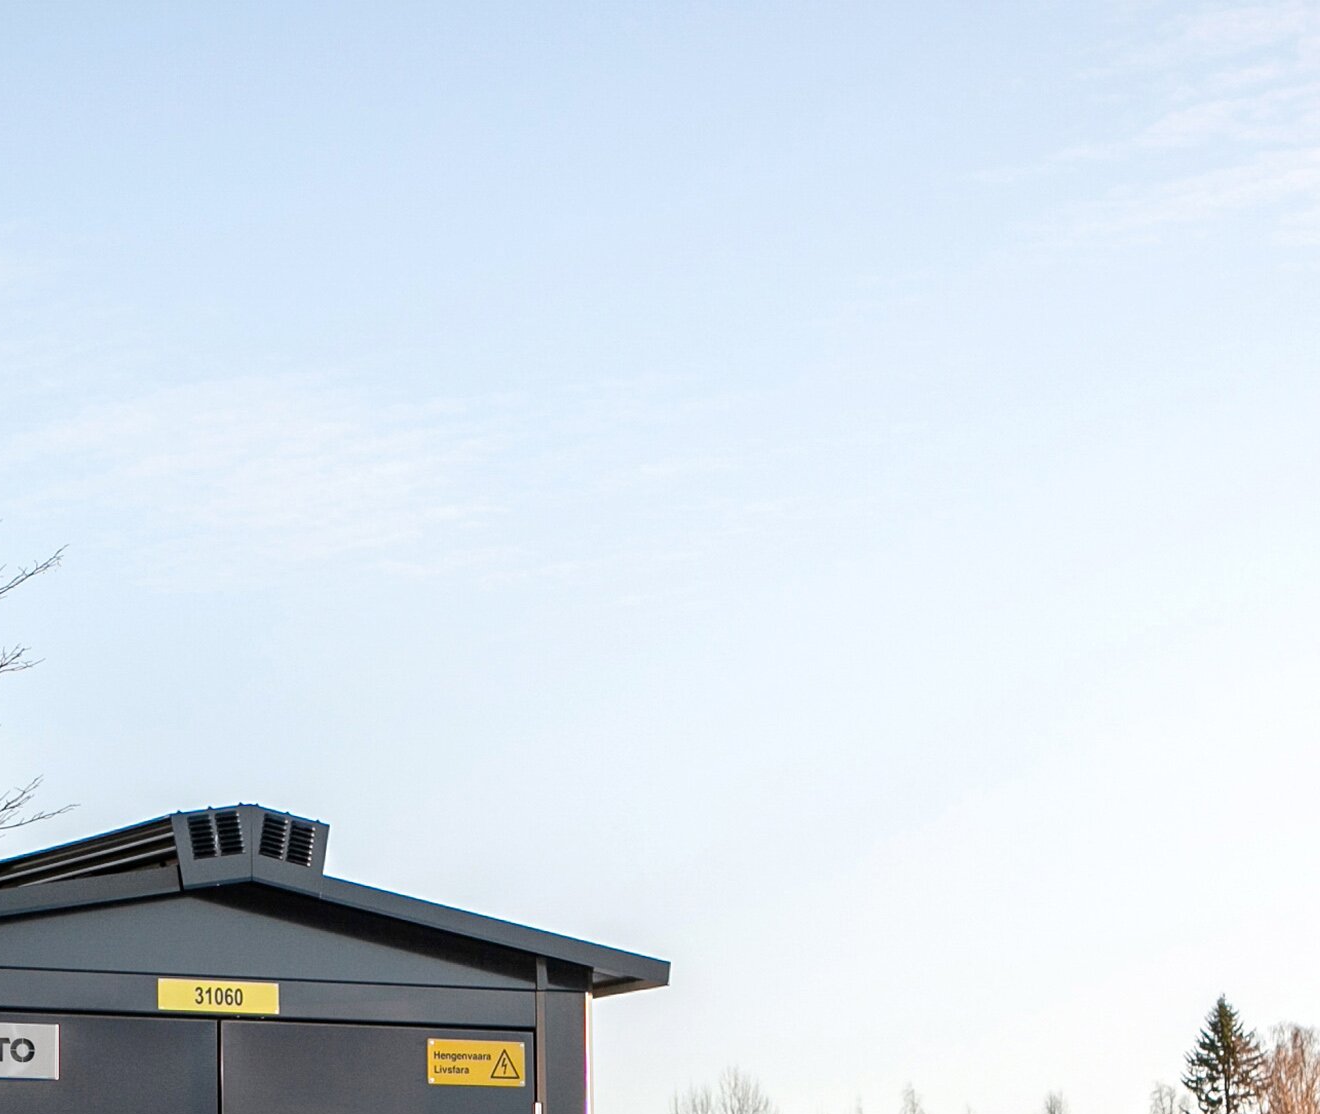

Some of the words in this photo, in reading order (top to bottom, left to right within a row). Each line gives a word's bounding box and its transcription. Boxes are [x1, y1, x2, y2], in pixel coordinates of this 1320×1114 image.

[194, 986, 244, 1006] 31060
[433, 1050, 492, 1062] Hengenvaara
[433, 1065, 470, 1074] Livsfara
